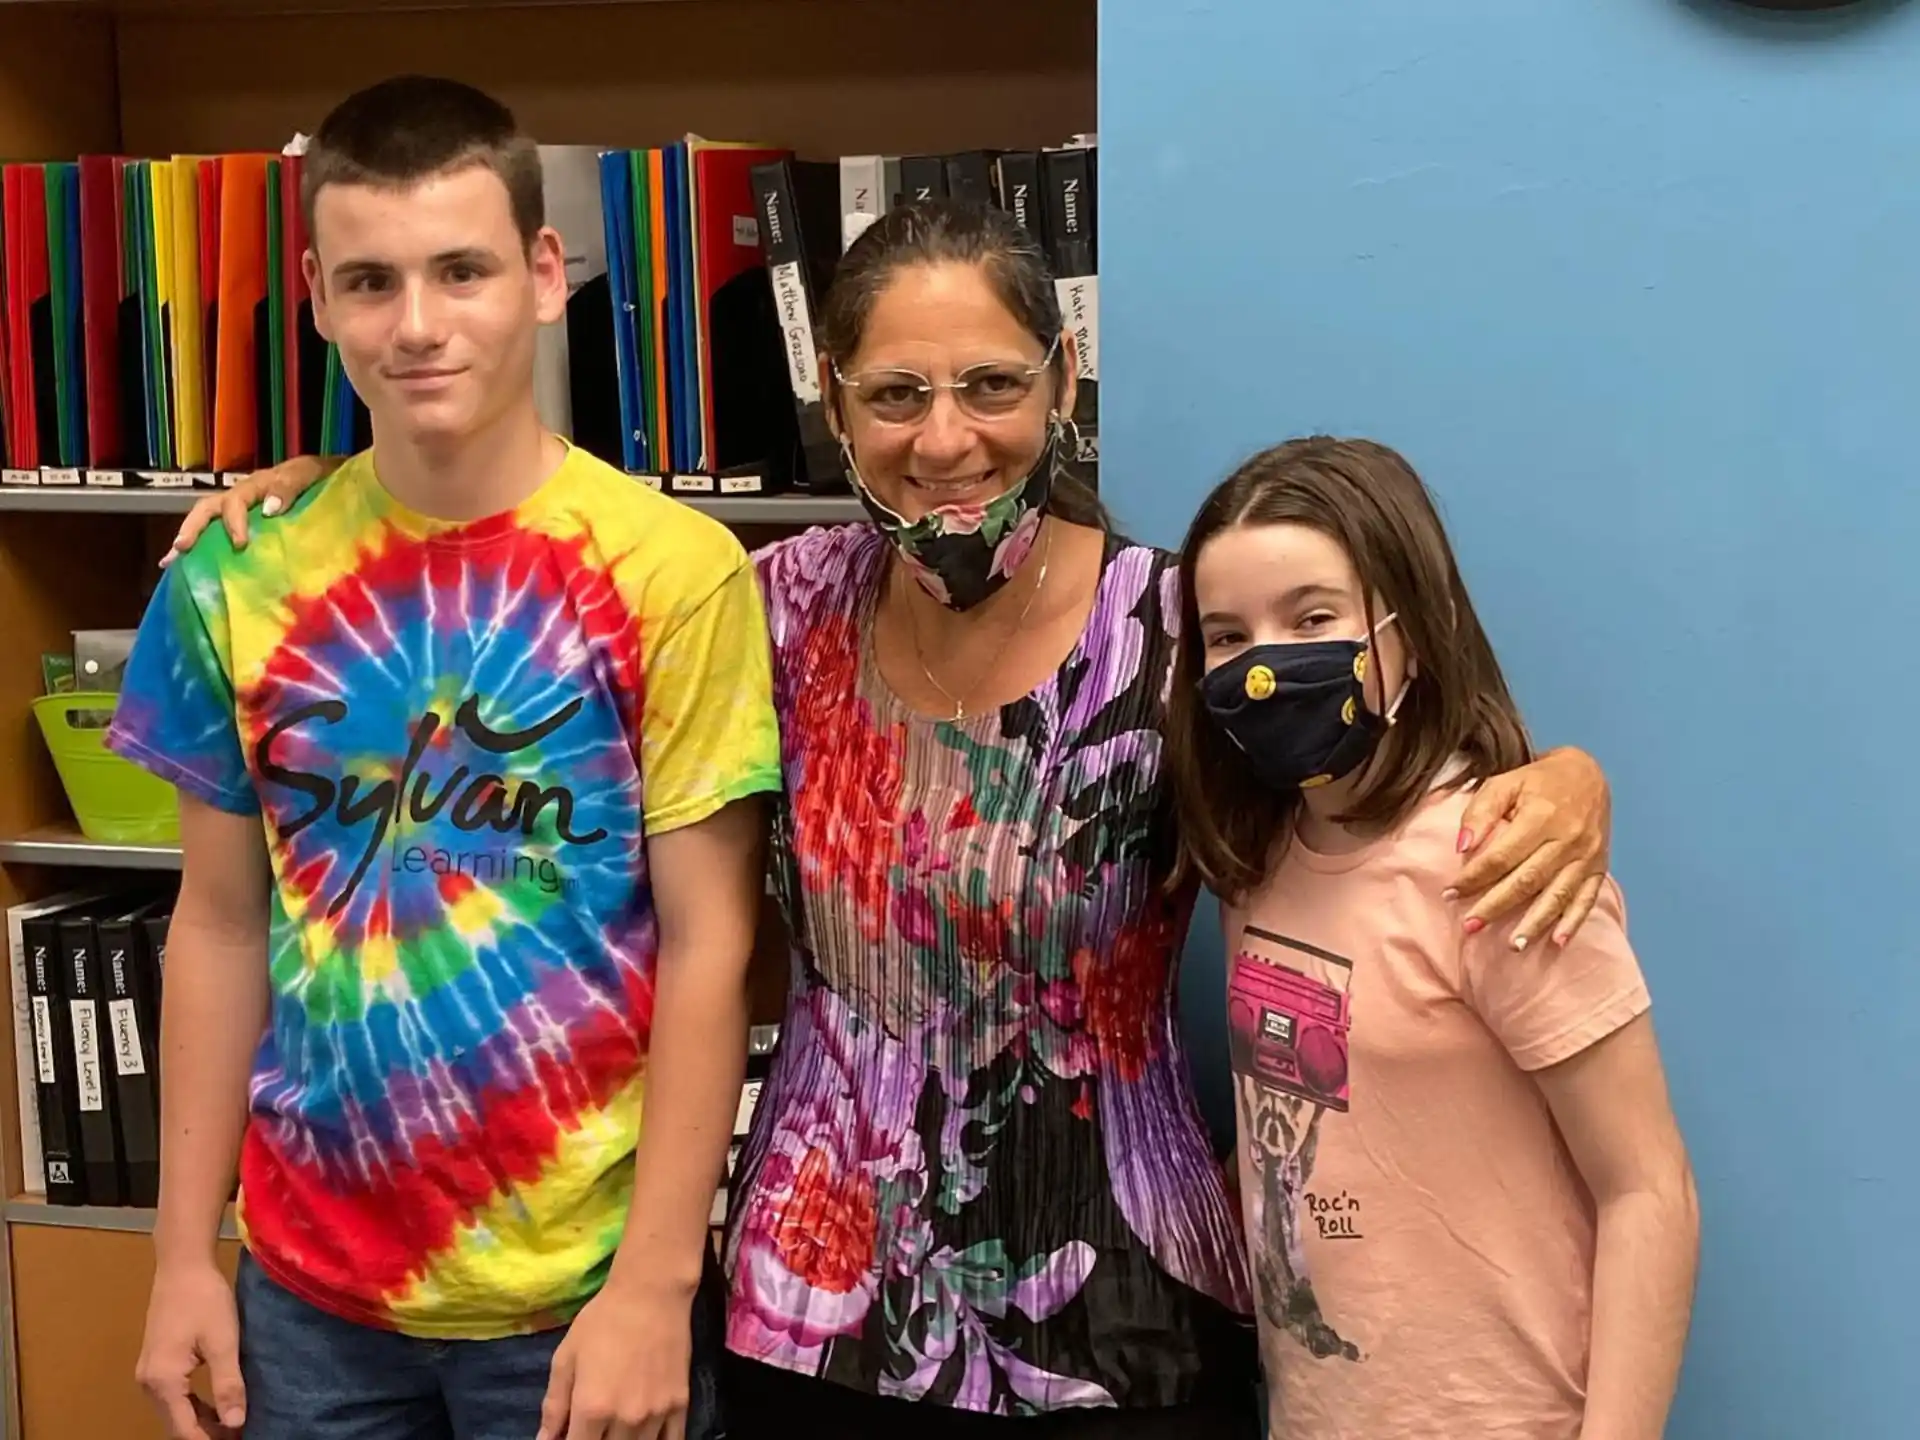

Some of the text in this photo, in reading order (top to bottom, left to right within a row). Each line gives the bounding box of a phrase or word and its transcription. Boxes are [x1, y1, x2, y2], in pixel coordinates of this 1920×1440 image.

[764, 190, 783, 244] Name:
[1013, 184, 1028, 229] Nam
[1063, 178, 1080, 233] Name:
[1070, 284, 1087, 320] Kate
[256, 700, 607, 918] Sylvan
[391, 838, 559, 893] Learning
[34, 946, 47, 992] Name:
[73, 948, 87, 994] Name:
[111, 949, 126, 995] Name:
[79, 1008, 92, 1055] Fluency
[124, 1059, 138, 1069] 3
[1304, 1190, 1360, 1217] Rac'n
[1314, 1215, 1354, 1239] Roll
